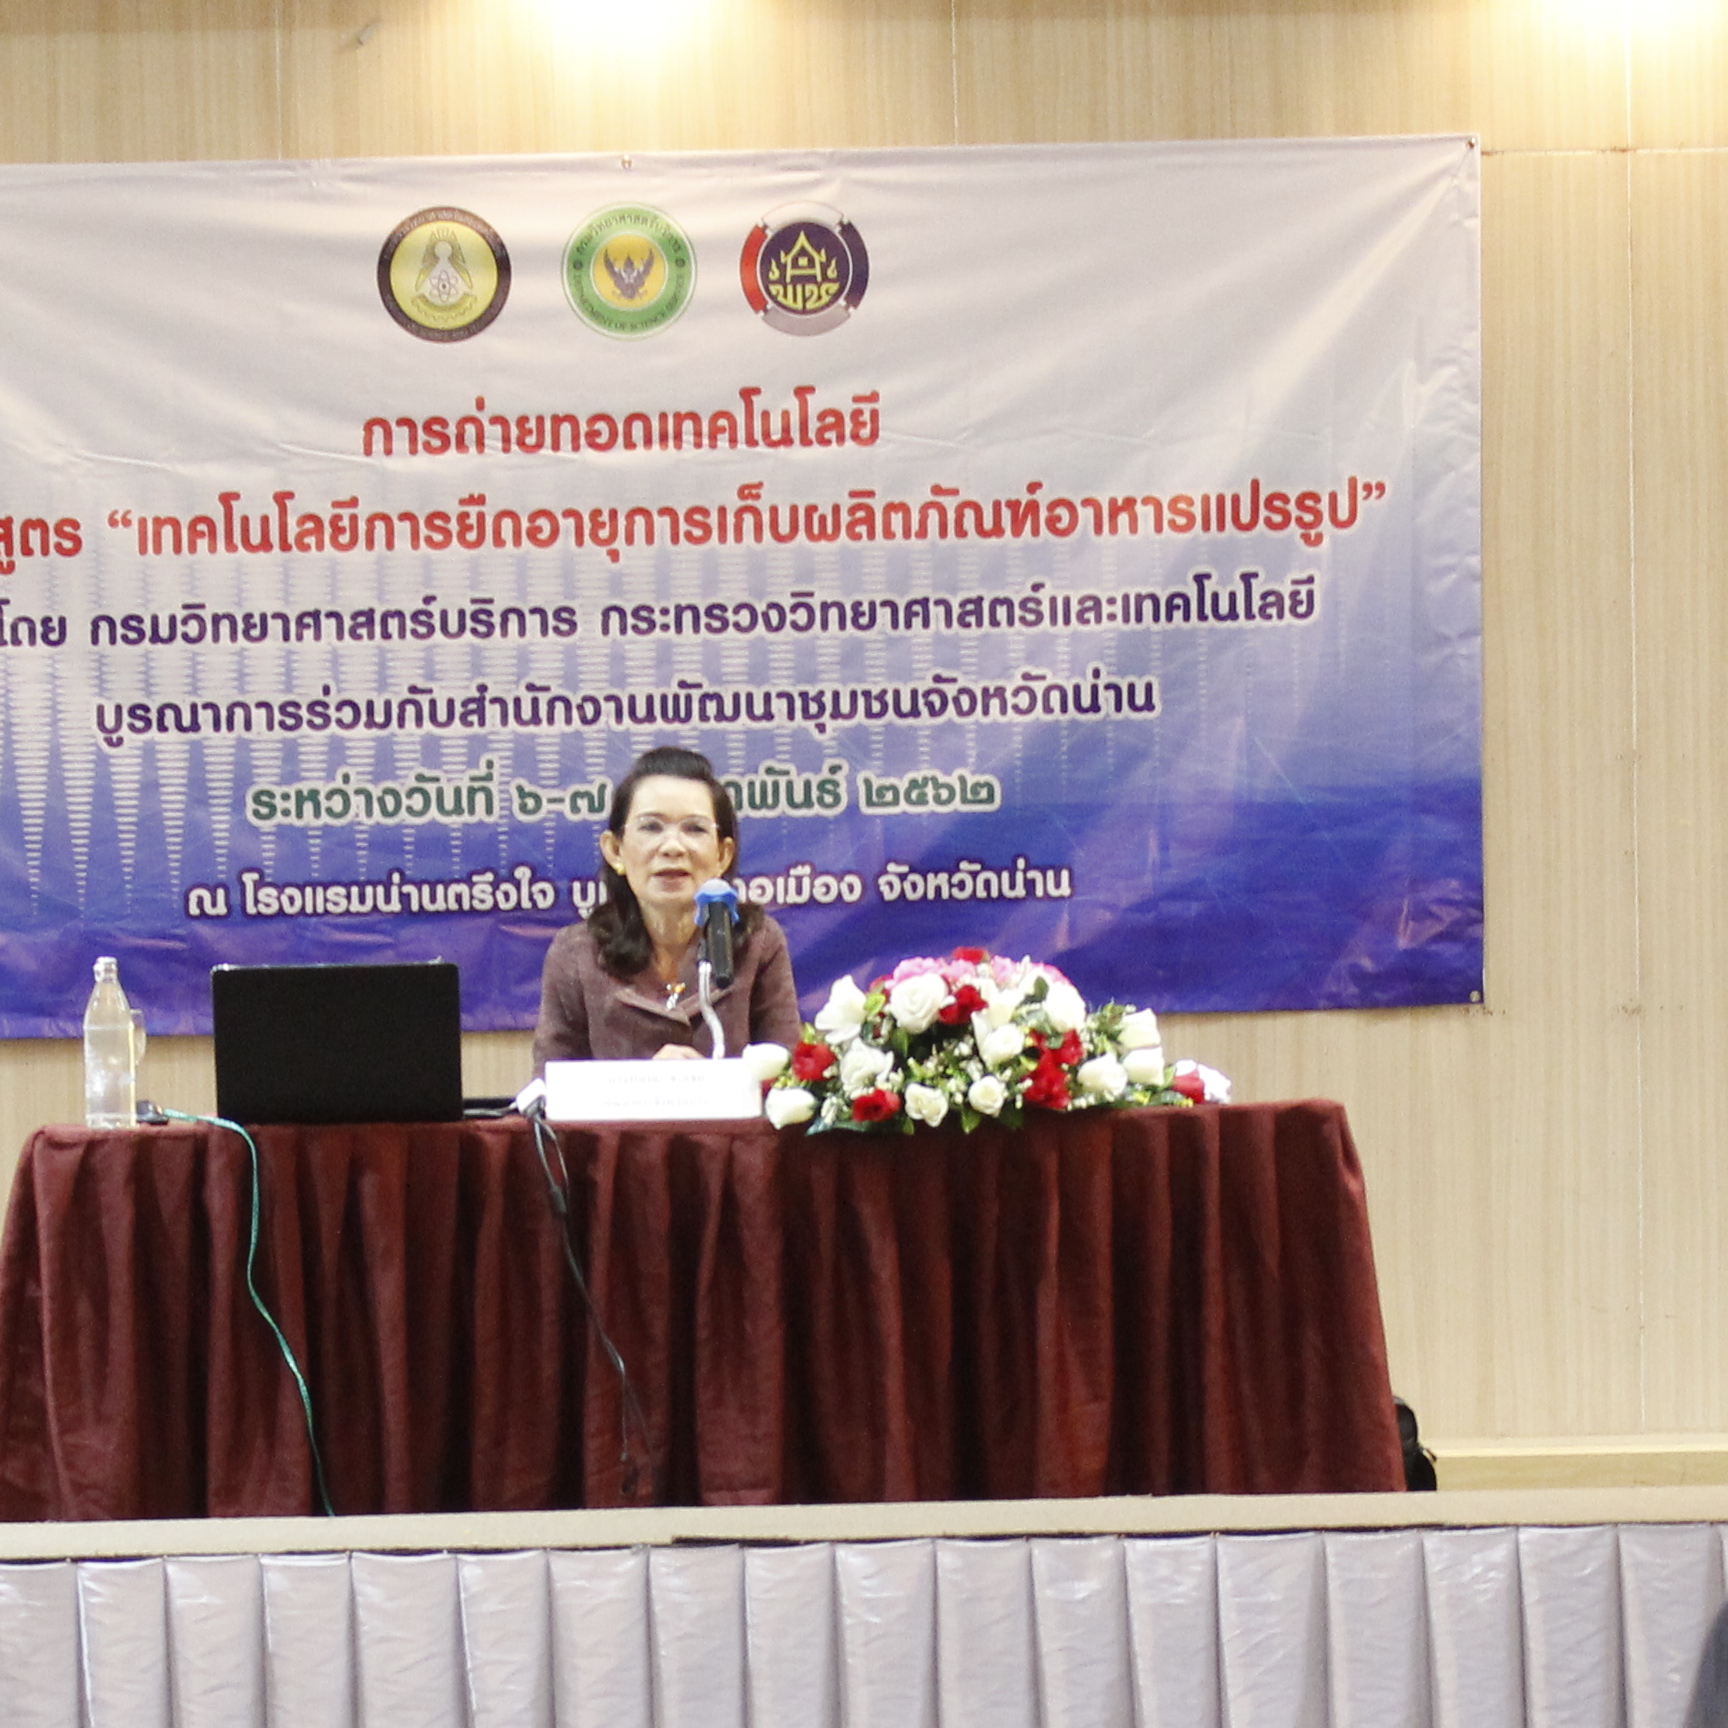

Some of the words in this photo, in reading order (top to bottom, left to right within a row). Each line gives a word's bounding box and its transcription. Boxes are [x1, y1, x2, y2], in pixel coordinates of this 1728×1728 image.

[362, 385, 881, 457] การถ่ายทอดเทคโนโลยี
[90, 595, 578, 646] กรมวิทยาศาสตร์บริการ
[600, 572, 1316, 637] กระทรวงวิทยาศาสตร์และเทคโนโลยี
[95, 667, 1156, 748] บูรณาการร่วมกับสำนักงานพัฒนาชุมชนจังหวัดน่าน
[251, 758, 495, 820] ระหว่างวันที่
[515, 783, 607, 815] ๖-๗
[863, 773, 996, 809] ๒๕๖๒
[188, 886, 226, 917] ณ
[242, 867, 555, 916] โรงแรมน่านตรึงใจ
[878, 856, 1072, 902] จังหวัดน่าน
